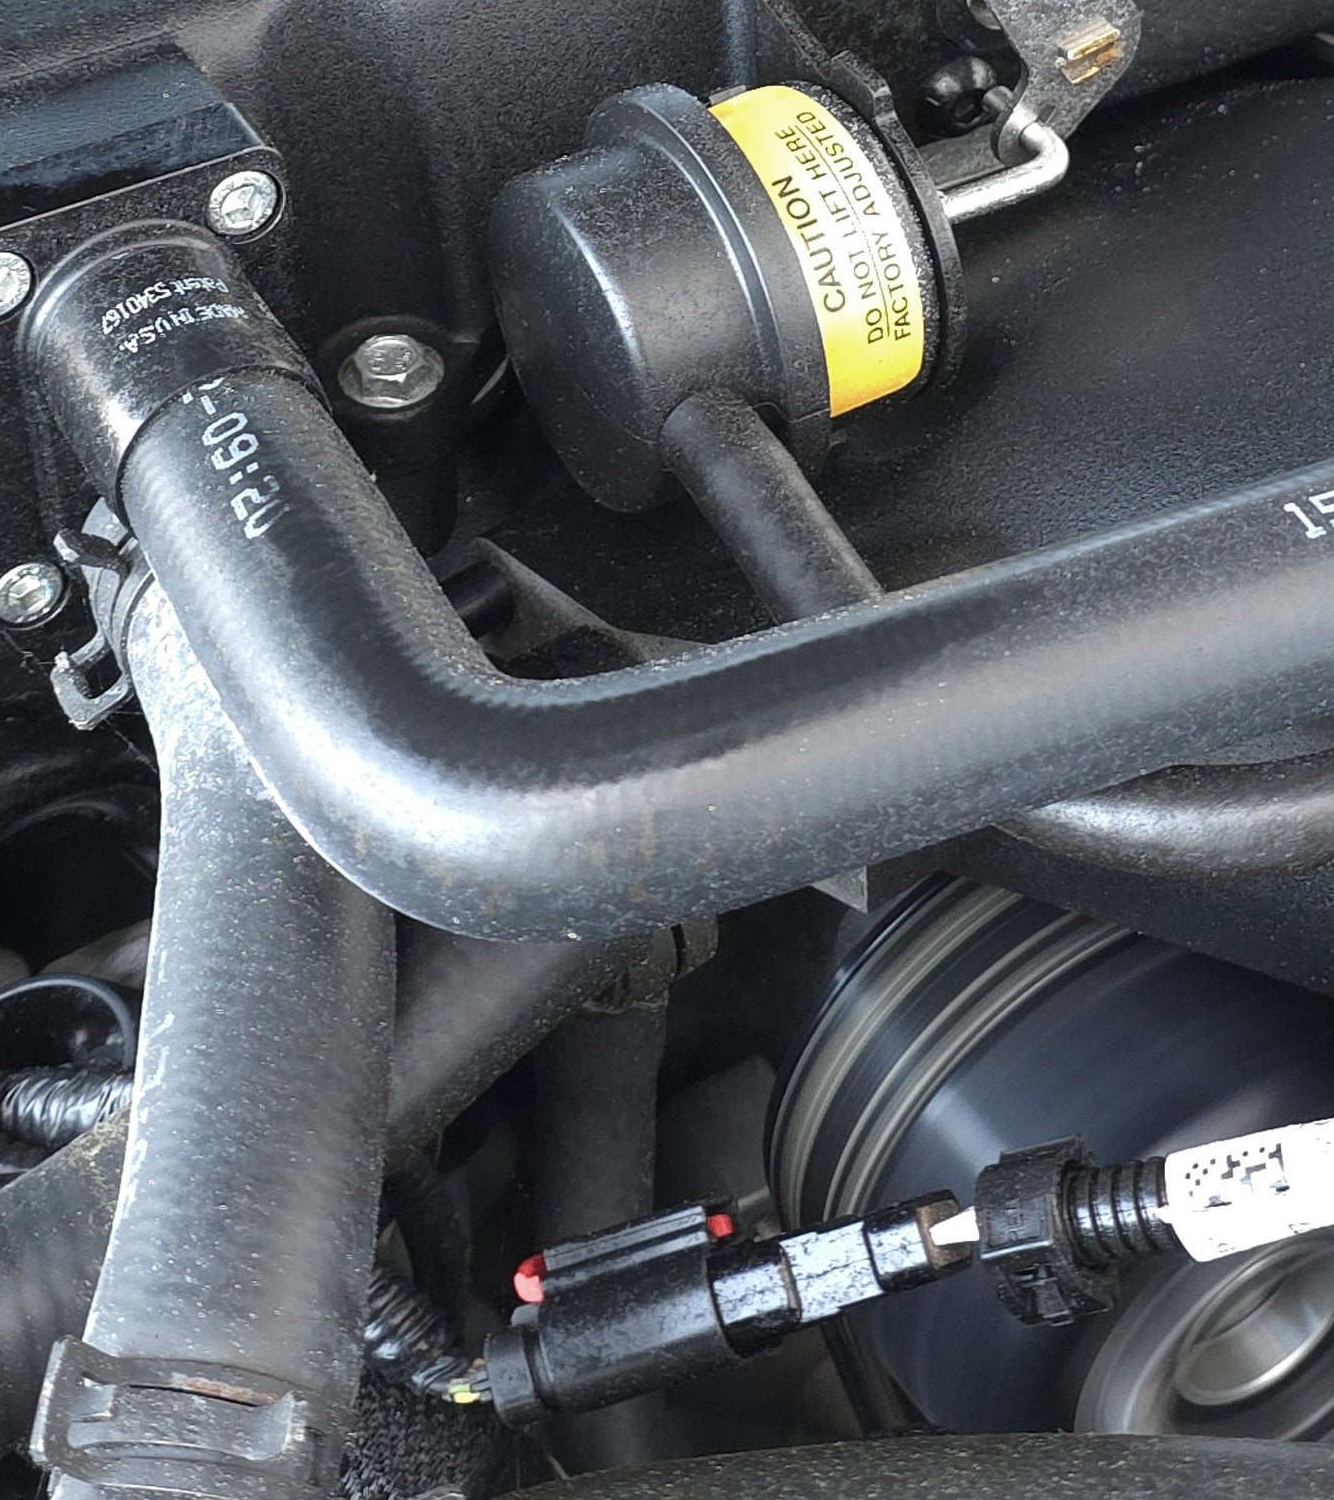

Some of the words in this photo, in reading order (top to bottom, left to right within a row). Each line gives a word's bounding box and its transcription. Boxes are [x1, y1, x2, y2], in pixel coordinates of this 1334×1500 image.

[774, 125, 828, 180] HERE
[796, 111, 881, 216] ADJUSTED
[818, 190, 857, 238] LIFT
[772, 175, 846, 313] CAUTION
[847, 250, 876, 300] NOT
[871, 232, 911, 341] FACTORY
[865, 308, 884, 345] DO
